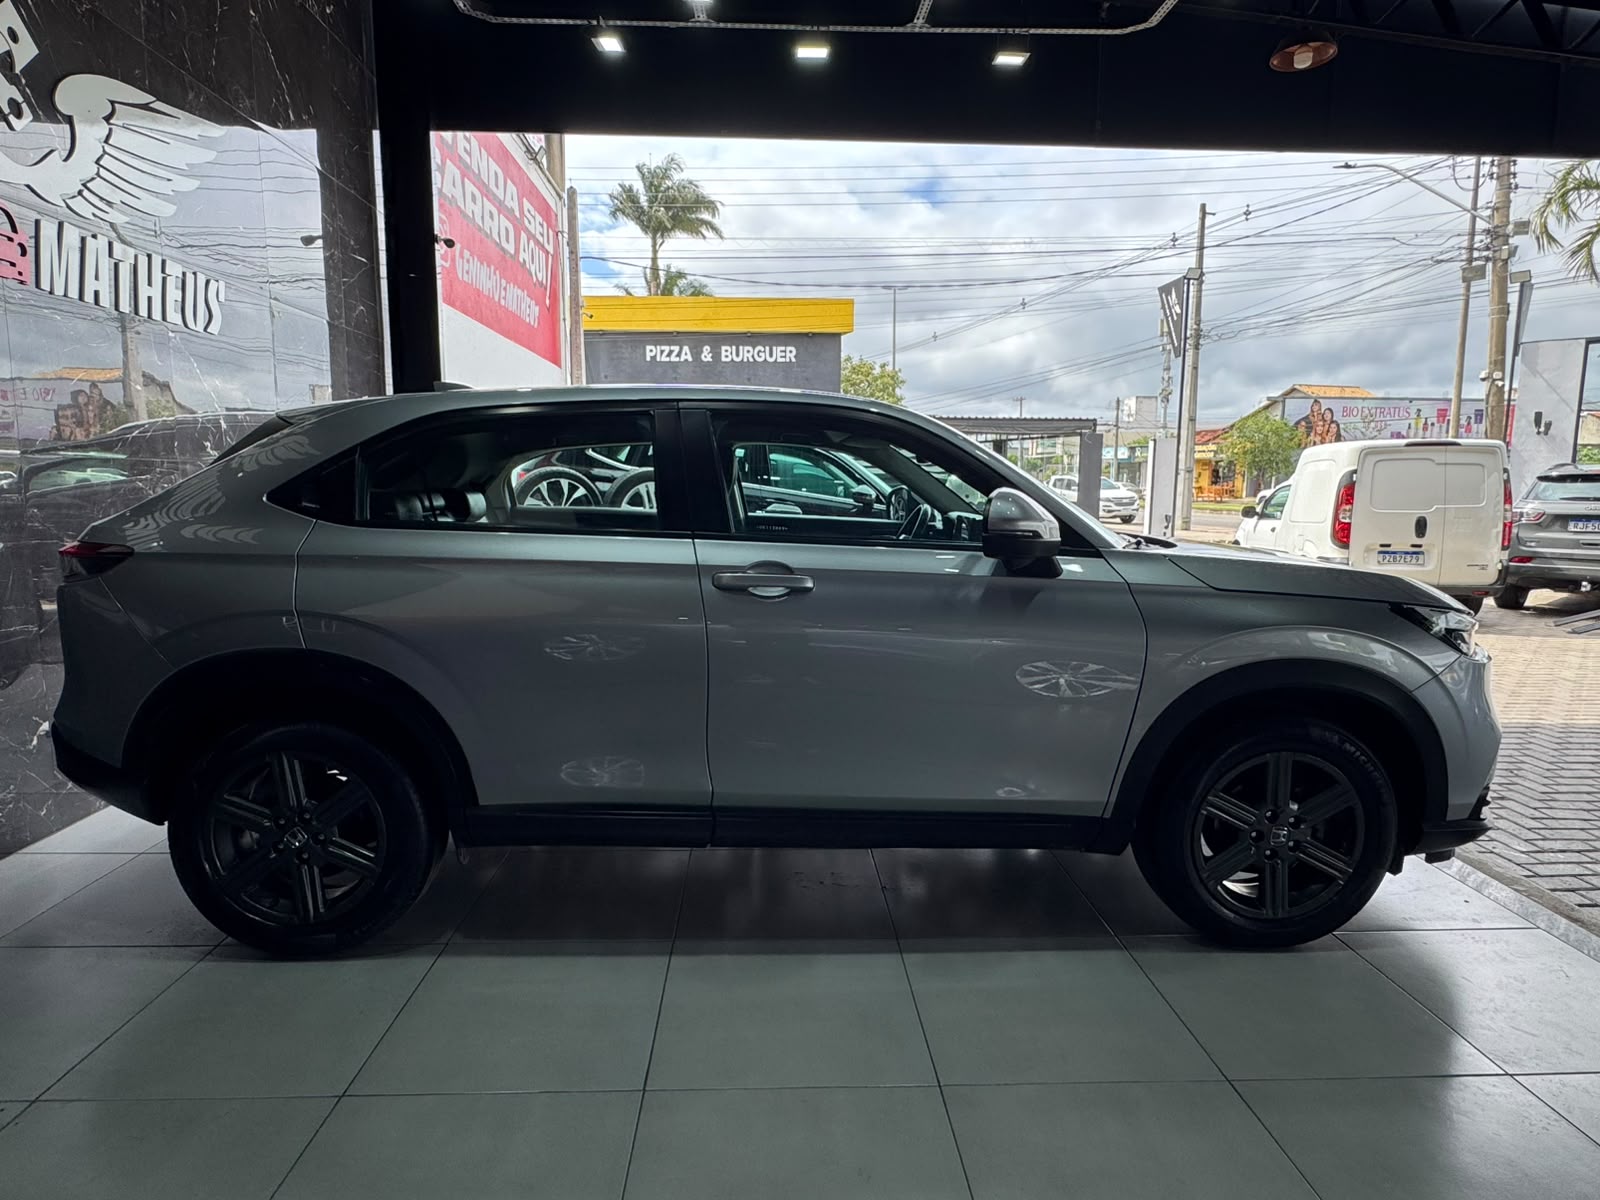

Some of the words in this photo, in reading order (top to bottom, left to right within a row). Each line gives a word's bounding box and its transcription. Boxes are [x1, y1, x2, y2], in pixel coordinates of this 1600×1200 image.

[523, 197, 554, 256] SEU
[35, 218, 225, 336] MATHEUS
[505, 282, 540, 328] MATHEUS
[645, 345, 693, 362] PIZZA
[701, 345, 713, 362] &
[720, 346, 797, 362] BURGUER
[1341, 405, 1360, 418] BIO
[1360, 406, 1412, 418] EXTRATUS
[1381, 554, 1420, 564] PZB7E79
